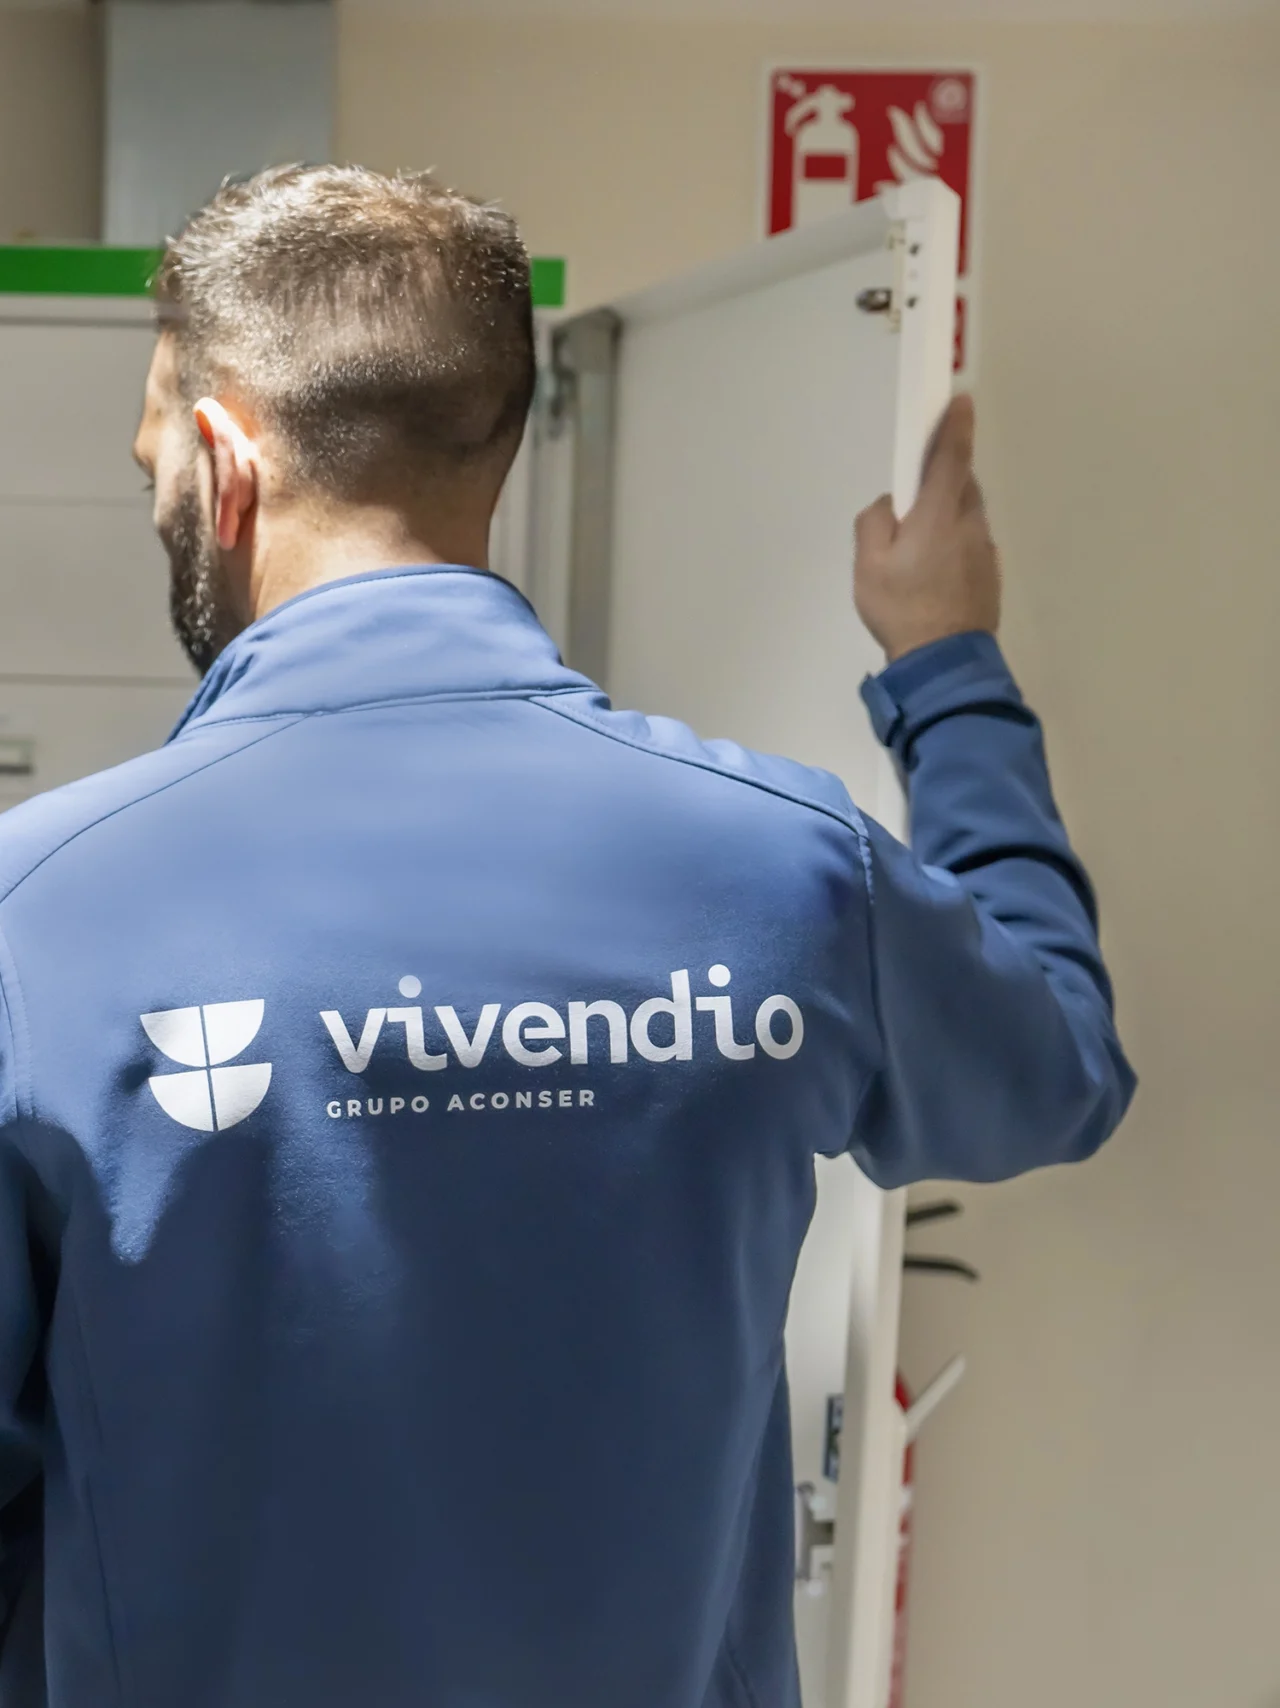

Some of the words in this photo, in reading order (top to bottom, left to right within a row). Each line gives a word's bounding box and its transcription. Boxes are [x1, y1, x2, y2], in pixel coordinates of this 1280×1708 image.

[321, 964, 804, 1073] vivendio
[326, 1095, 430, 1118] GRUPO
[448, 1089, 596, 1112] ACONSER
